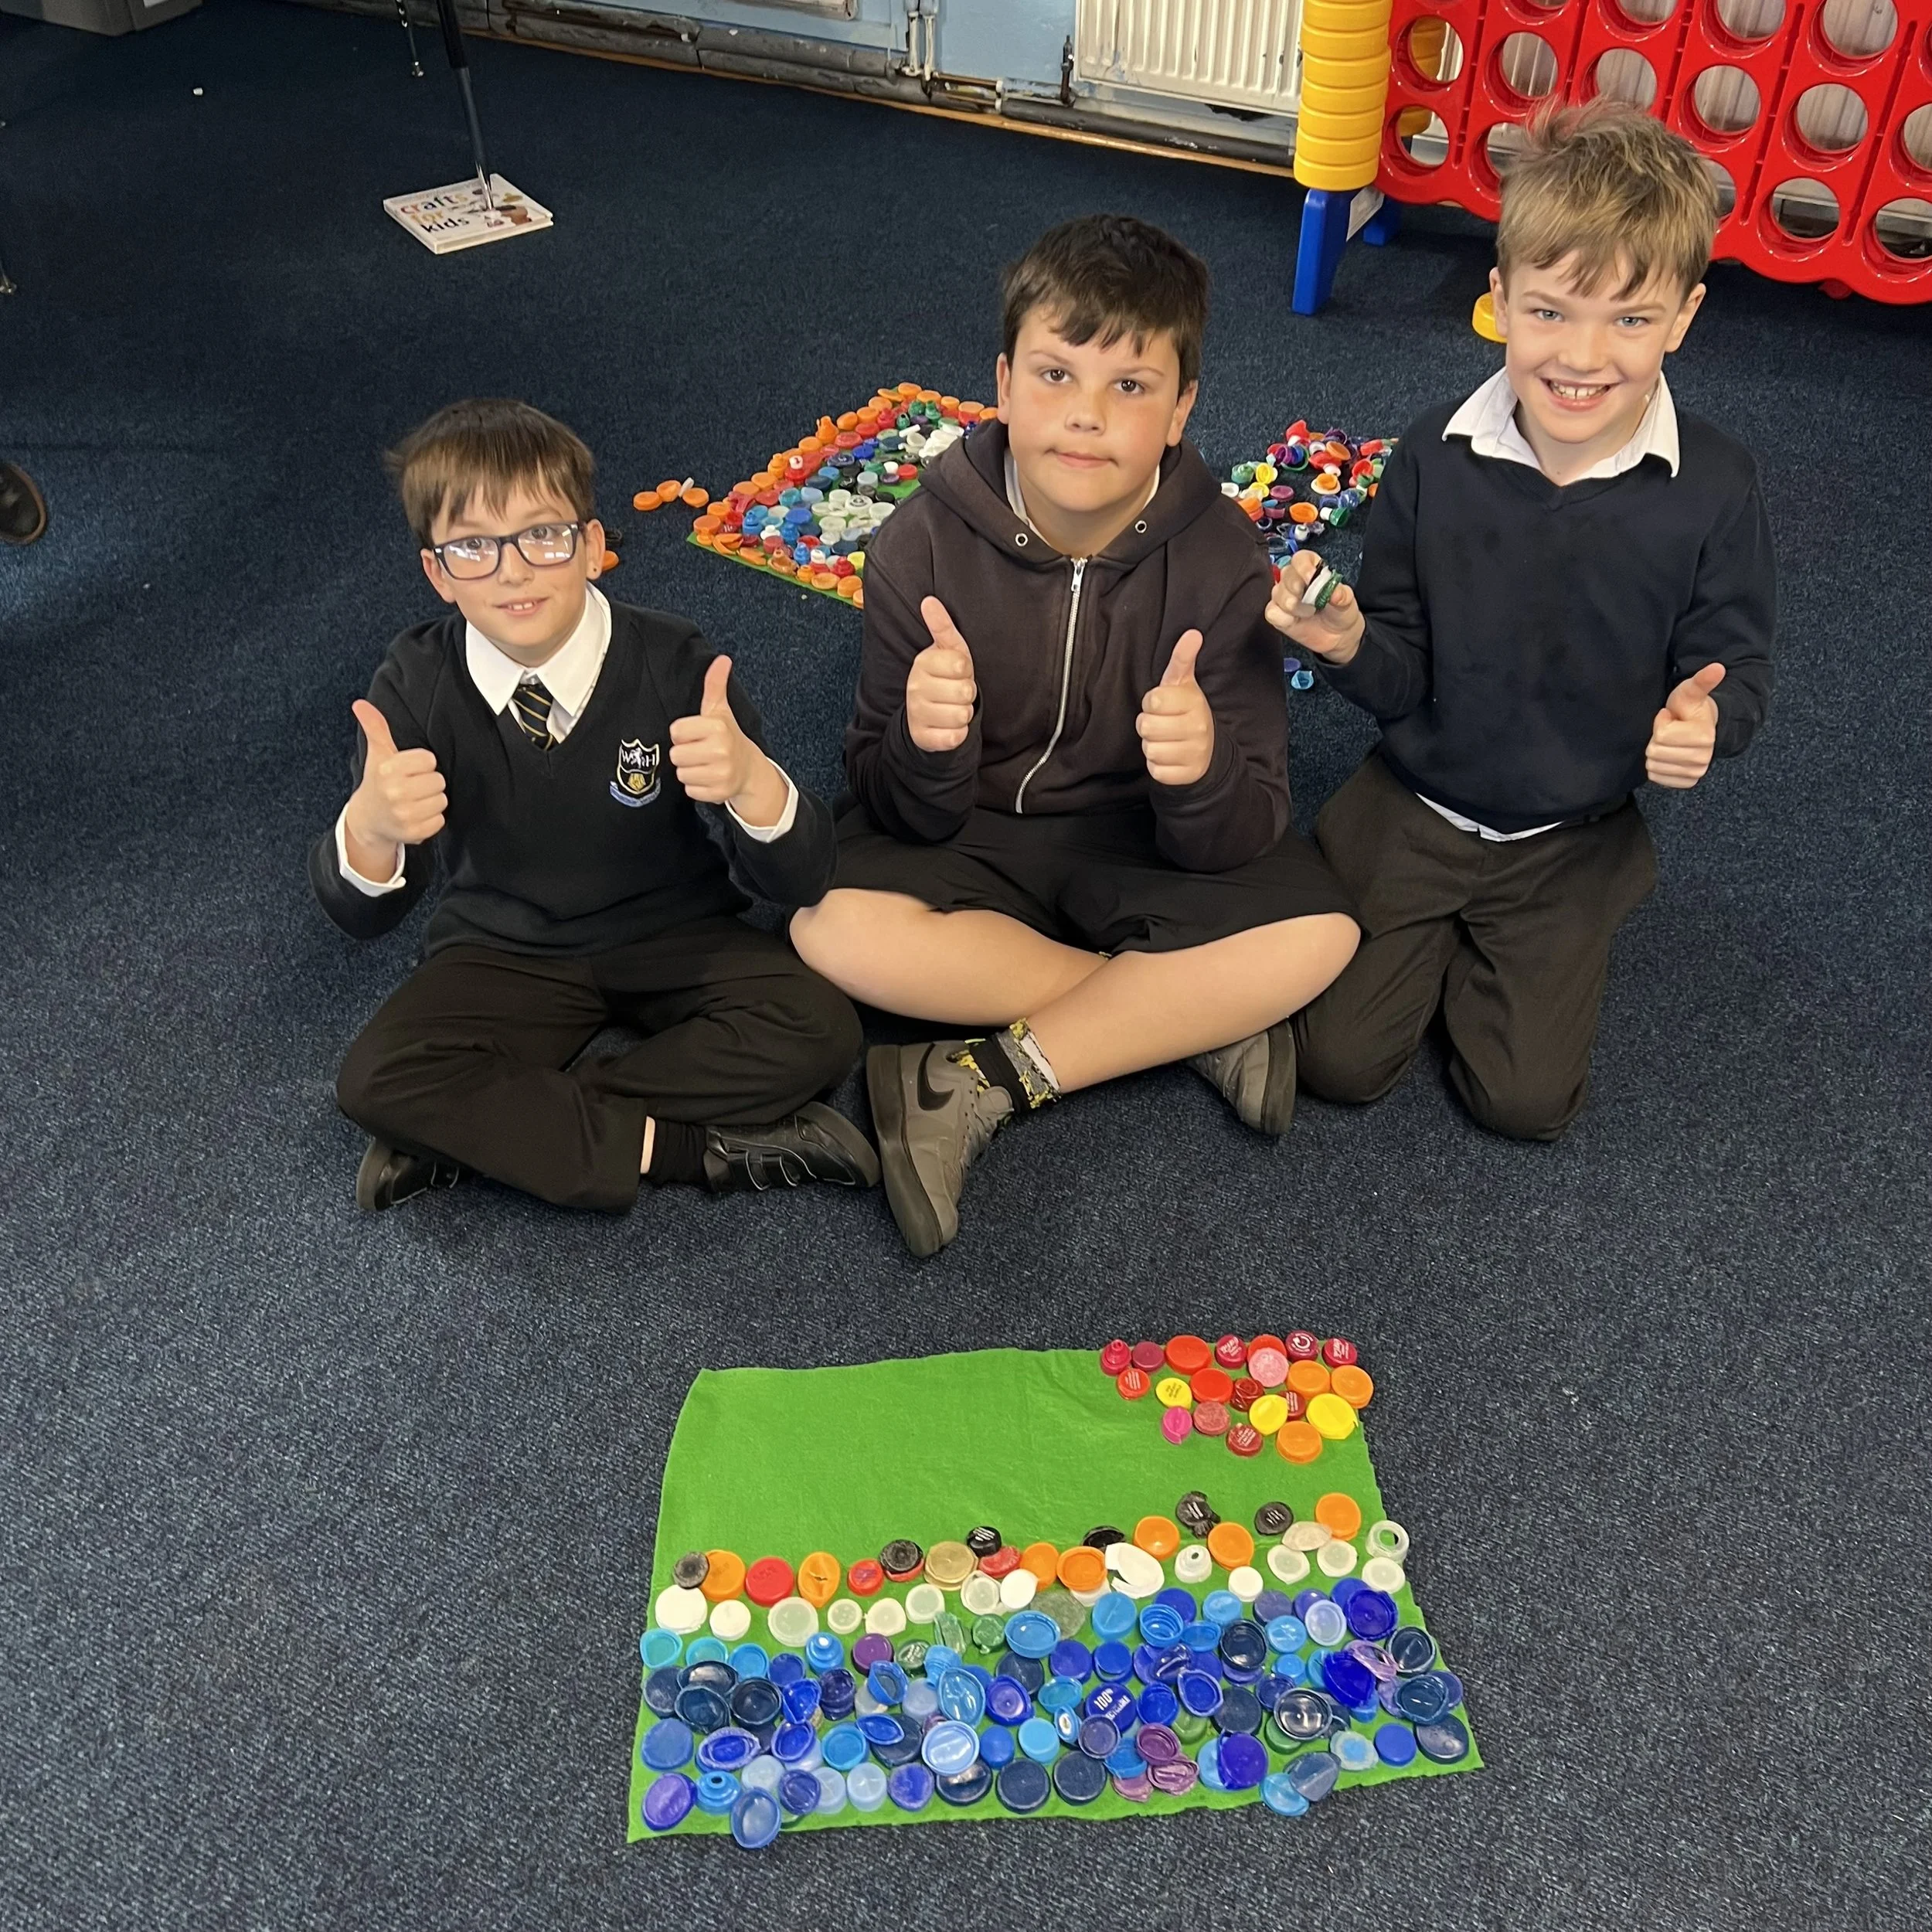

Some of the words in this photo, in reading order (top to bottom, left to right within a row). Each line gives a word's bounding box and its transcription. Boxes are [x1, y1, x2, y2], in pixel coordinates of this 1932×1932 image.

[400, 194, 468, 213] crafts
[410, 209, 444, 226] for
[420, 217, 470, 233] kids
